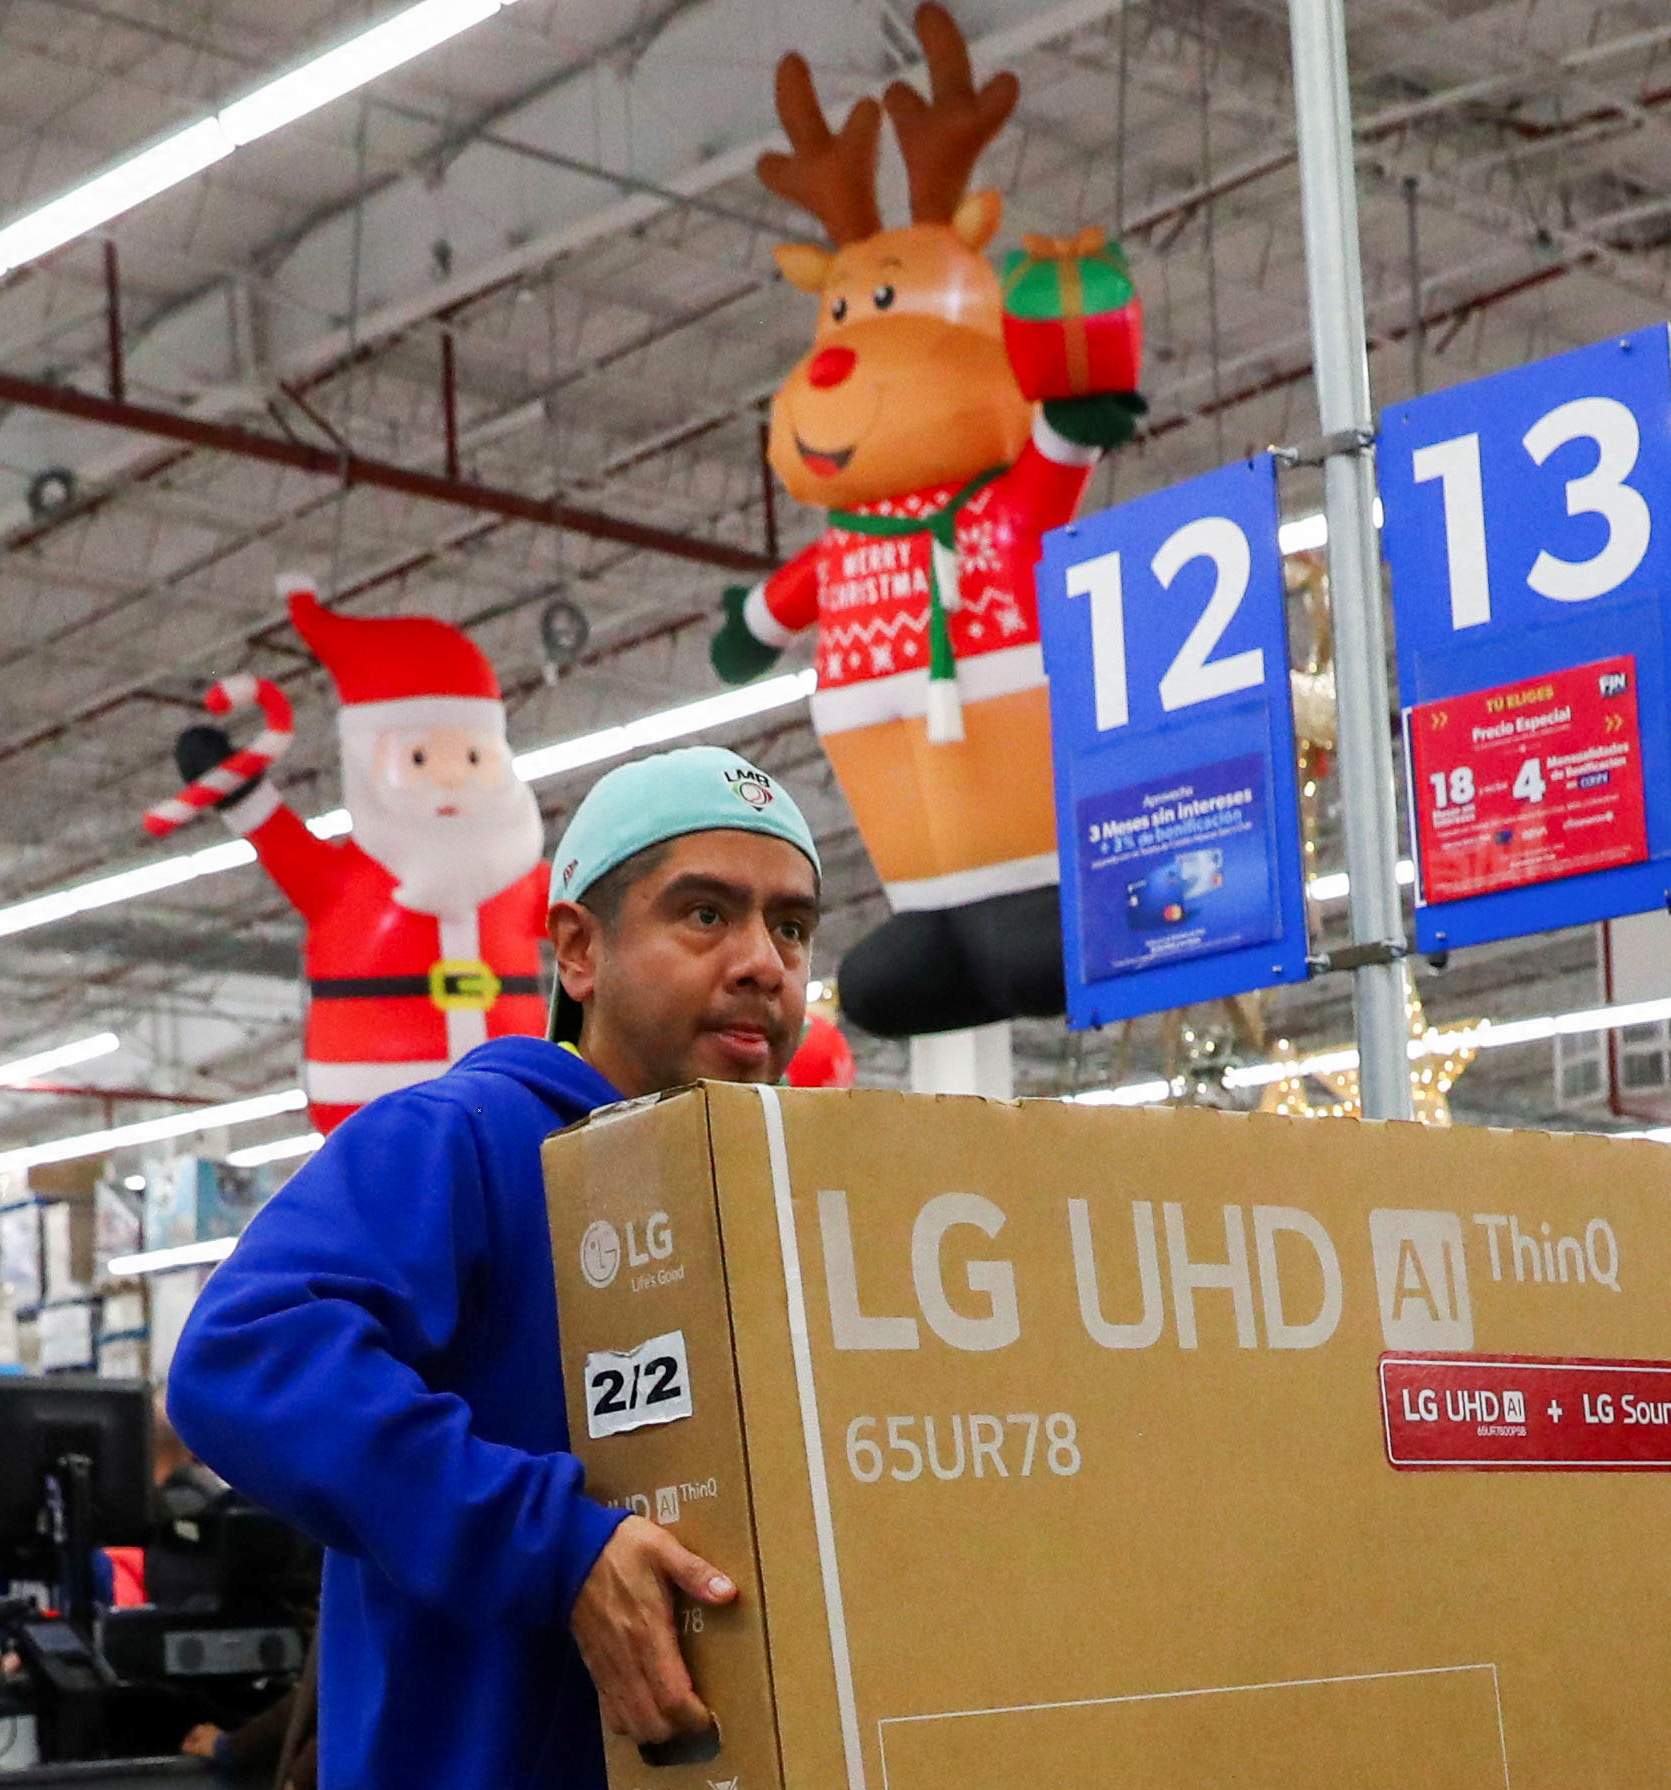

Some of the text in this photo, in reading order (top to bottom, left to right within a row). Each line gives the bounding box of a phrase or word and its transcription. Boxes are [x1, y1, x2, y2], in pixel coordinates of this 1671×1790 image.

[1412, 397, 1652, 630] 13
[843, 541, 910, 578] MERRY
[1065, 516, 1265, 732] 12
[1472, 722, 1514, 743] Precio
[1516, 706, 1572, 734] Especial
[723, 768, 771, 788] LMB
[1430, 766, 1476, 809] 18
[1512, 757, 1547, 803] 4
[1088, 787, 1254, 843] 3 Meses sin intereses
[626, 1212, 673, 1267] LG
[657, 1264, 684, 1285] Good
[816, 1190, 1021, 1352] LG
[1067, 1197, 1343, 1351] UHD
[1472, 1212, 1622, 1293] ThinQ
[590, 1354, 682, 1418] 2/2
[1402, 1388, 1439, 1423] LG
[1446, 1389, 1500, 1422] UHD
[1504, 1391, 1526, 1423] AI
[1583, 1393, 1616, 1424] LG
[845, 1412, 1082, 1483] 65UR78
[680, 1478, 718, 1502] ThinQ
